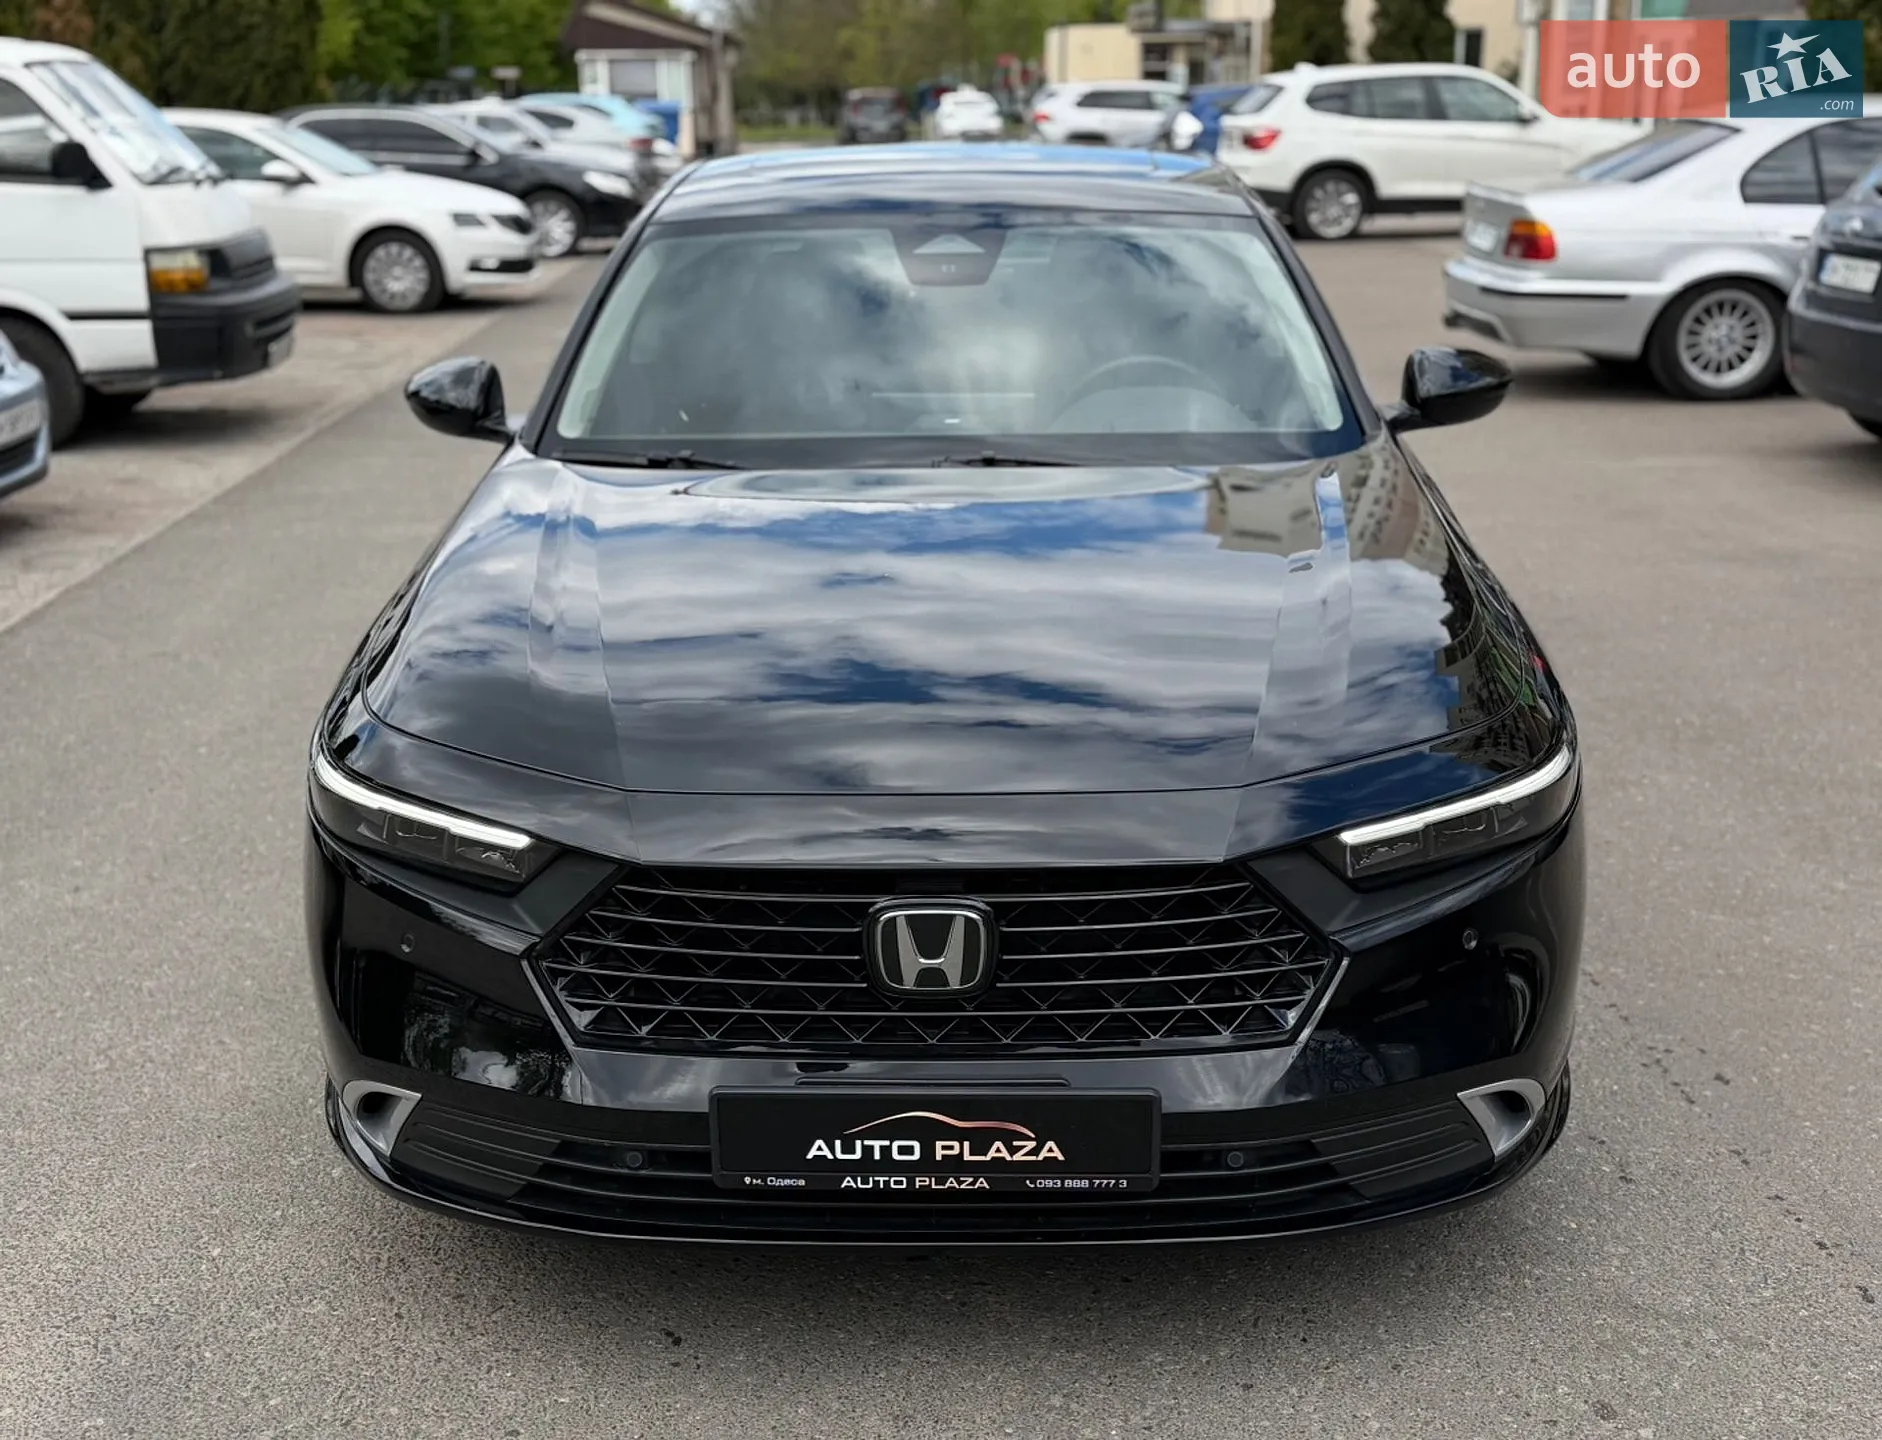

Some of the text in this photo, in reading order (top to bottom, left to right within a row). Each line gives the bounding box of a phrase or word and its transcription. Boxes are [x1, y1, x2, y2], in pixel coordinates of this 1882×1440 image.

[806, 1139, 1065, 1161] AUTO PLAZA
[767, 1176, 806, 1187] Одеса
[840, 1176, 990, 1189] AUTO PLAZA
[1036, 1179, 1128, 1188] 093 888 777 3
